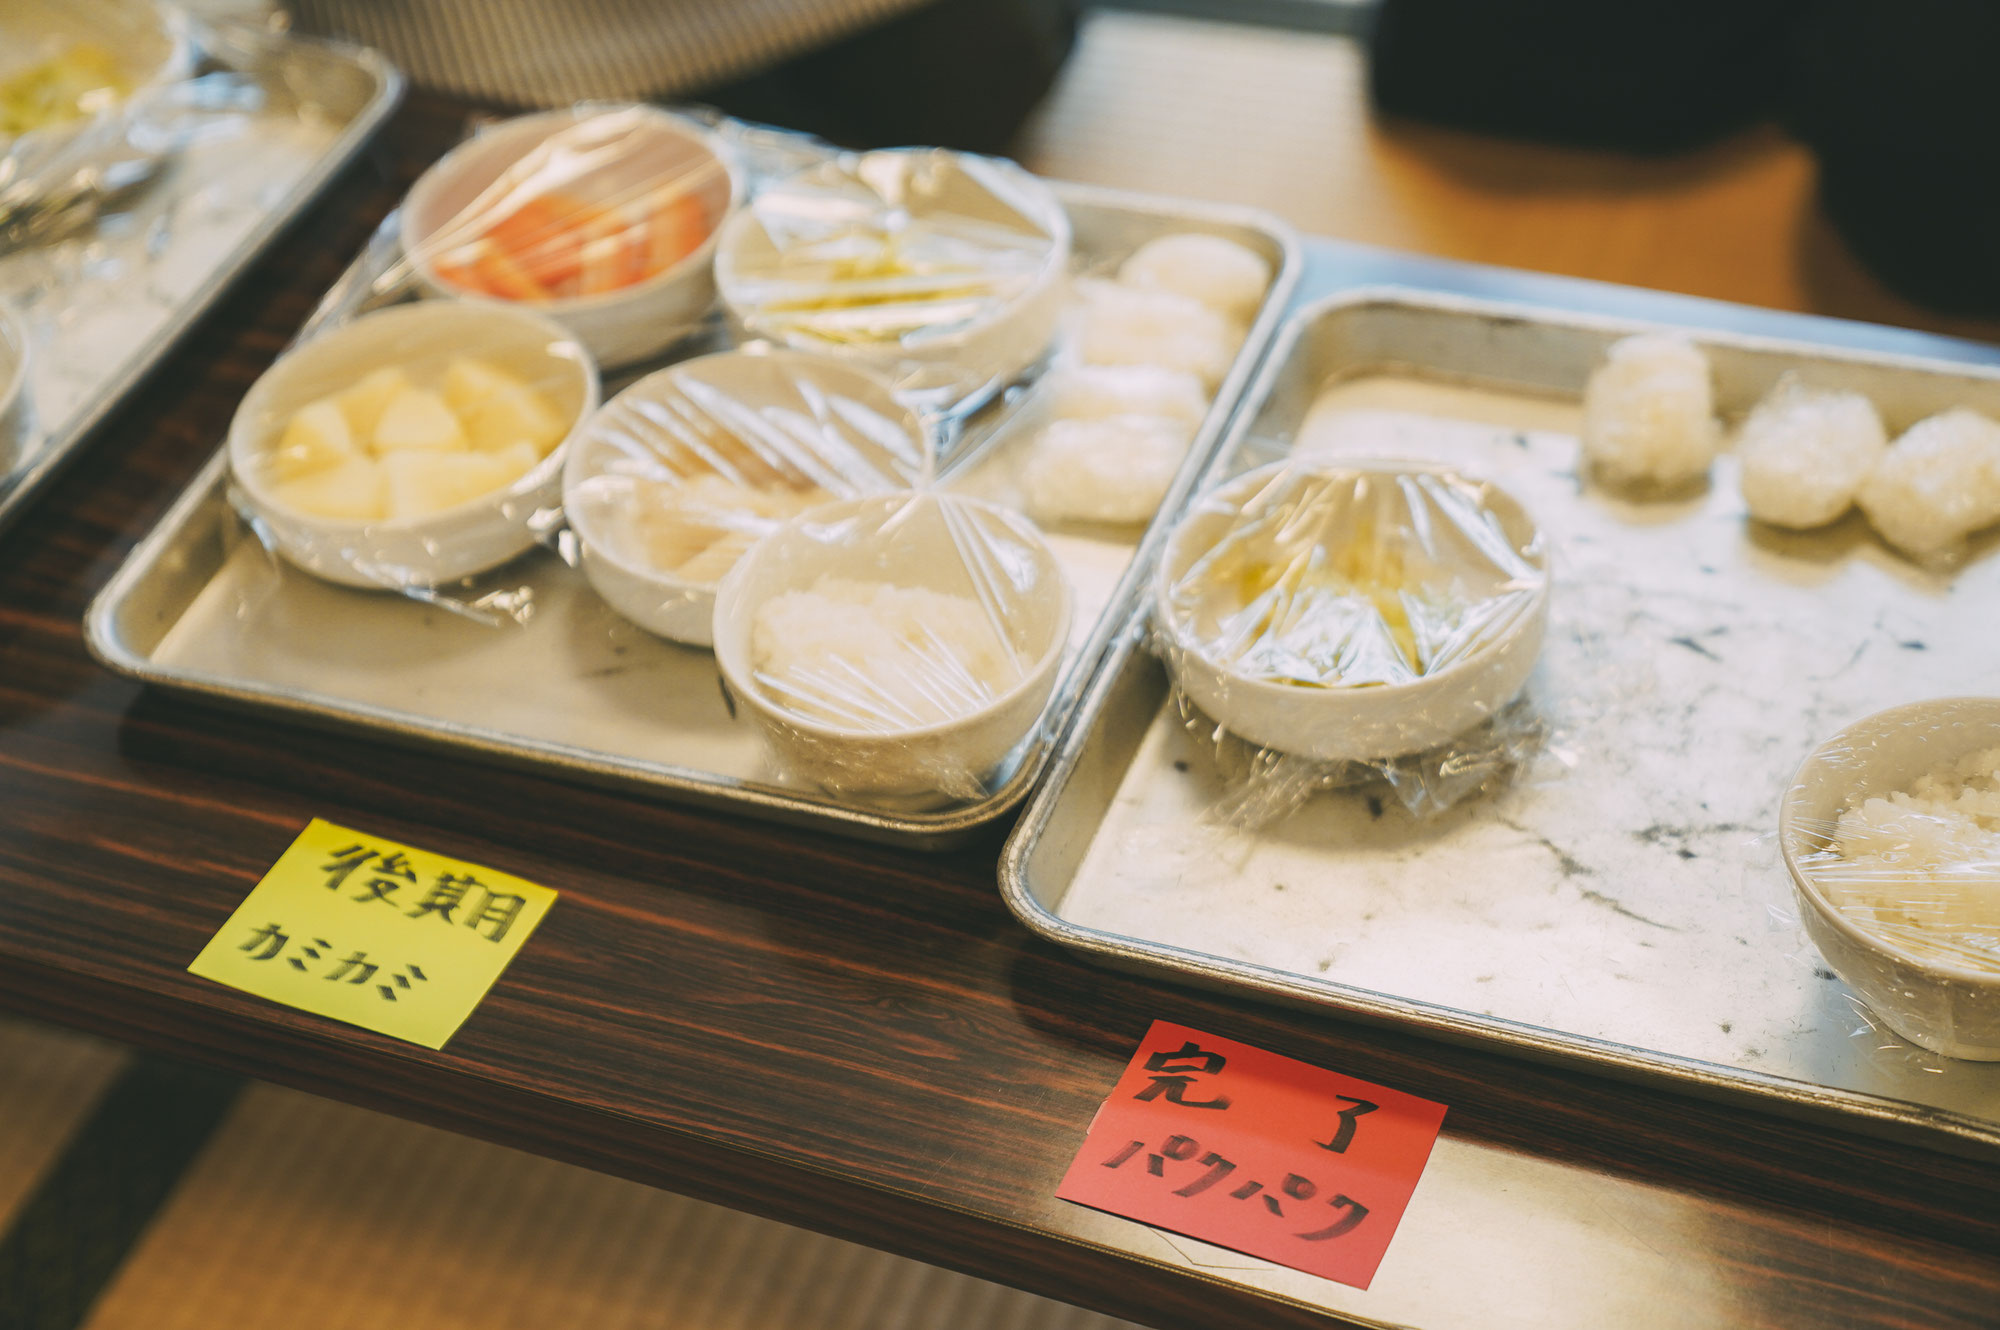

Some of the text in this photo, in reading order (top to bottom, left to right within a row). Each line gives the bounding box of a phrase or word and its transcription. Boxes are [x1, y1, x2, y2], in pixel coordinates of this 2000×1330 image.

[320, 842, 527, 943] 後期
[237, 922, 428, 1002] カミカミ
[1100, 1134, 1370, 1241] パクパク
